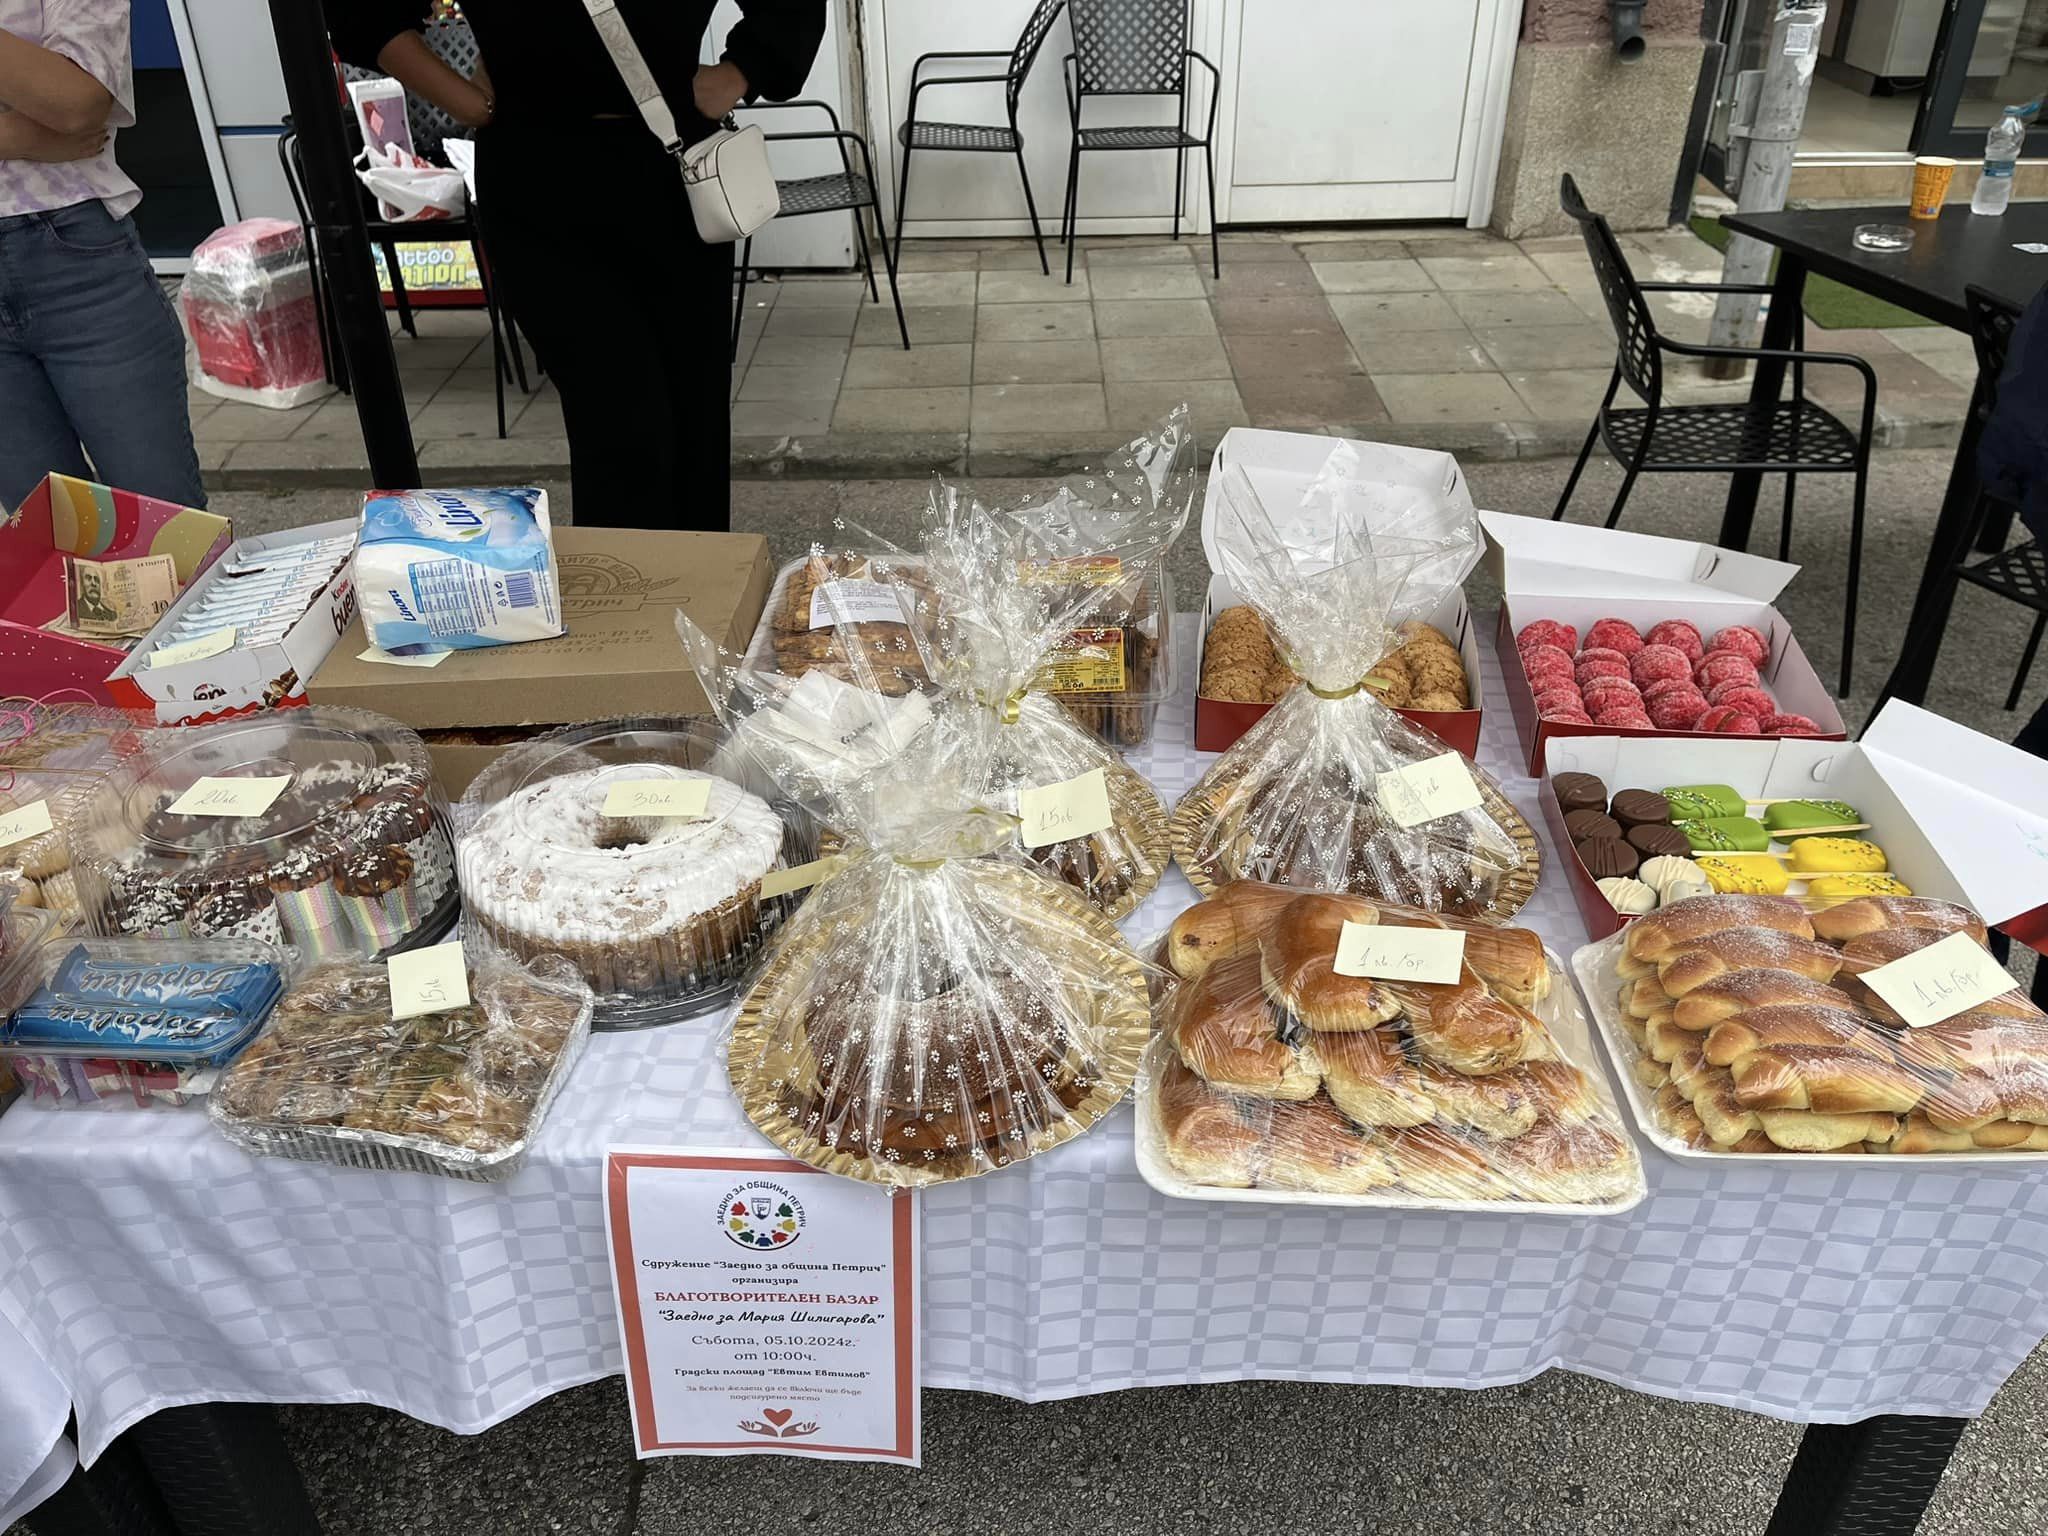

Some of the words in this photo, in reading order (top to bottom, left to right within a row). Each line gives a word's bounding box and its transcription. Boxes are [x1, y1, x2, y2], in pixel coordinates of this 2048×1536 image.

[331, 583, 357, 637] buen
[717, 1192, 734, 1226] ЗАЕДНО
[732, 1184, 747, 1196] ЗА
[746, 1180, 789, 1197] ОБЩИНА
[788, 1195, 807, 1228] ПЕТРИЧ
[641, 1259, 711, 1270] Сдружение
[765, 1263, 778, 1271] за
[781, 1262, 829, 1272] община
[732, 1277, 799, 1286] организира
[654, 1291, 820, 1303] БЛАГОТВОРИТЕЛЕН
[825, 1294, 880, 1305] БАЗАР
[715, 1313, 735, 1326] за
[738, 1311, 785, 1325] Мария
[691, 1335, 760, 1347] Събота,
[764, 1335, 856, 1347] 05.10.2024г.
[734, 1352, 758, 1361] от
[763, 1351, 817, 1361] 10:00ч.
[674, 1368, 720, 1377] Градски
[723, 1368, 765, 1377] площад
